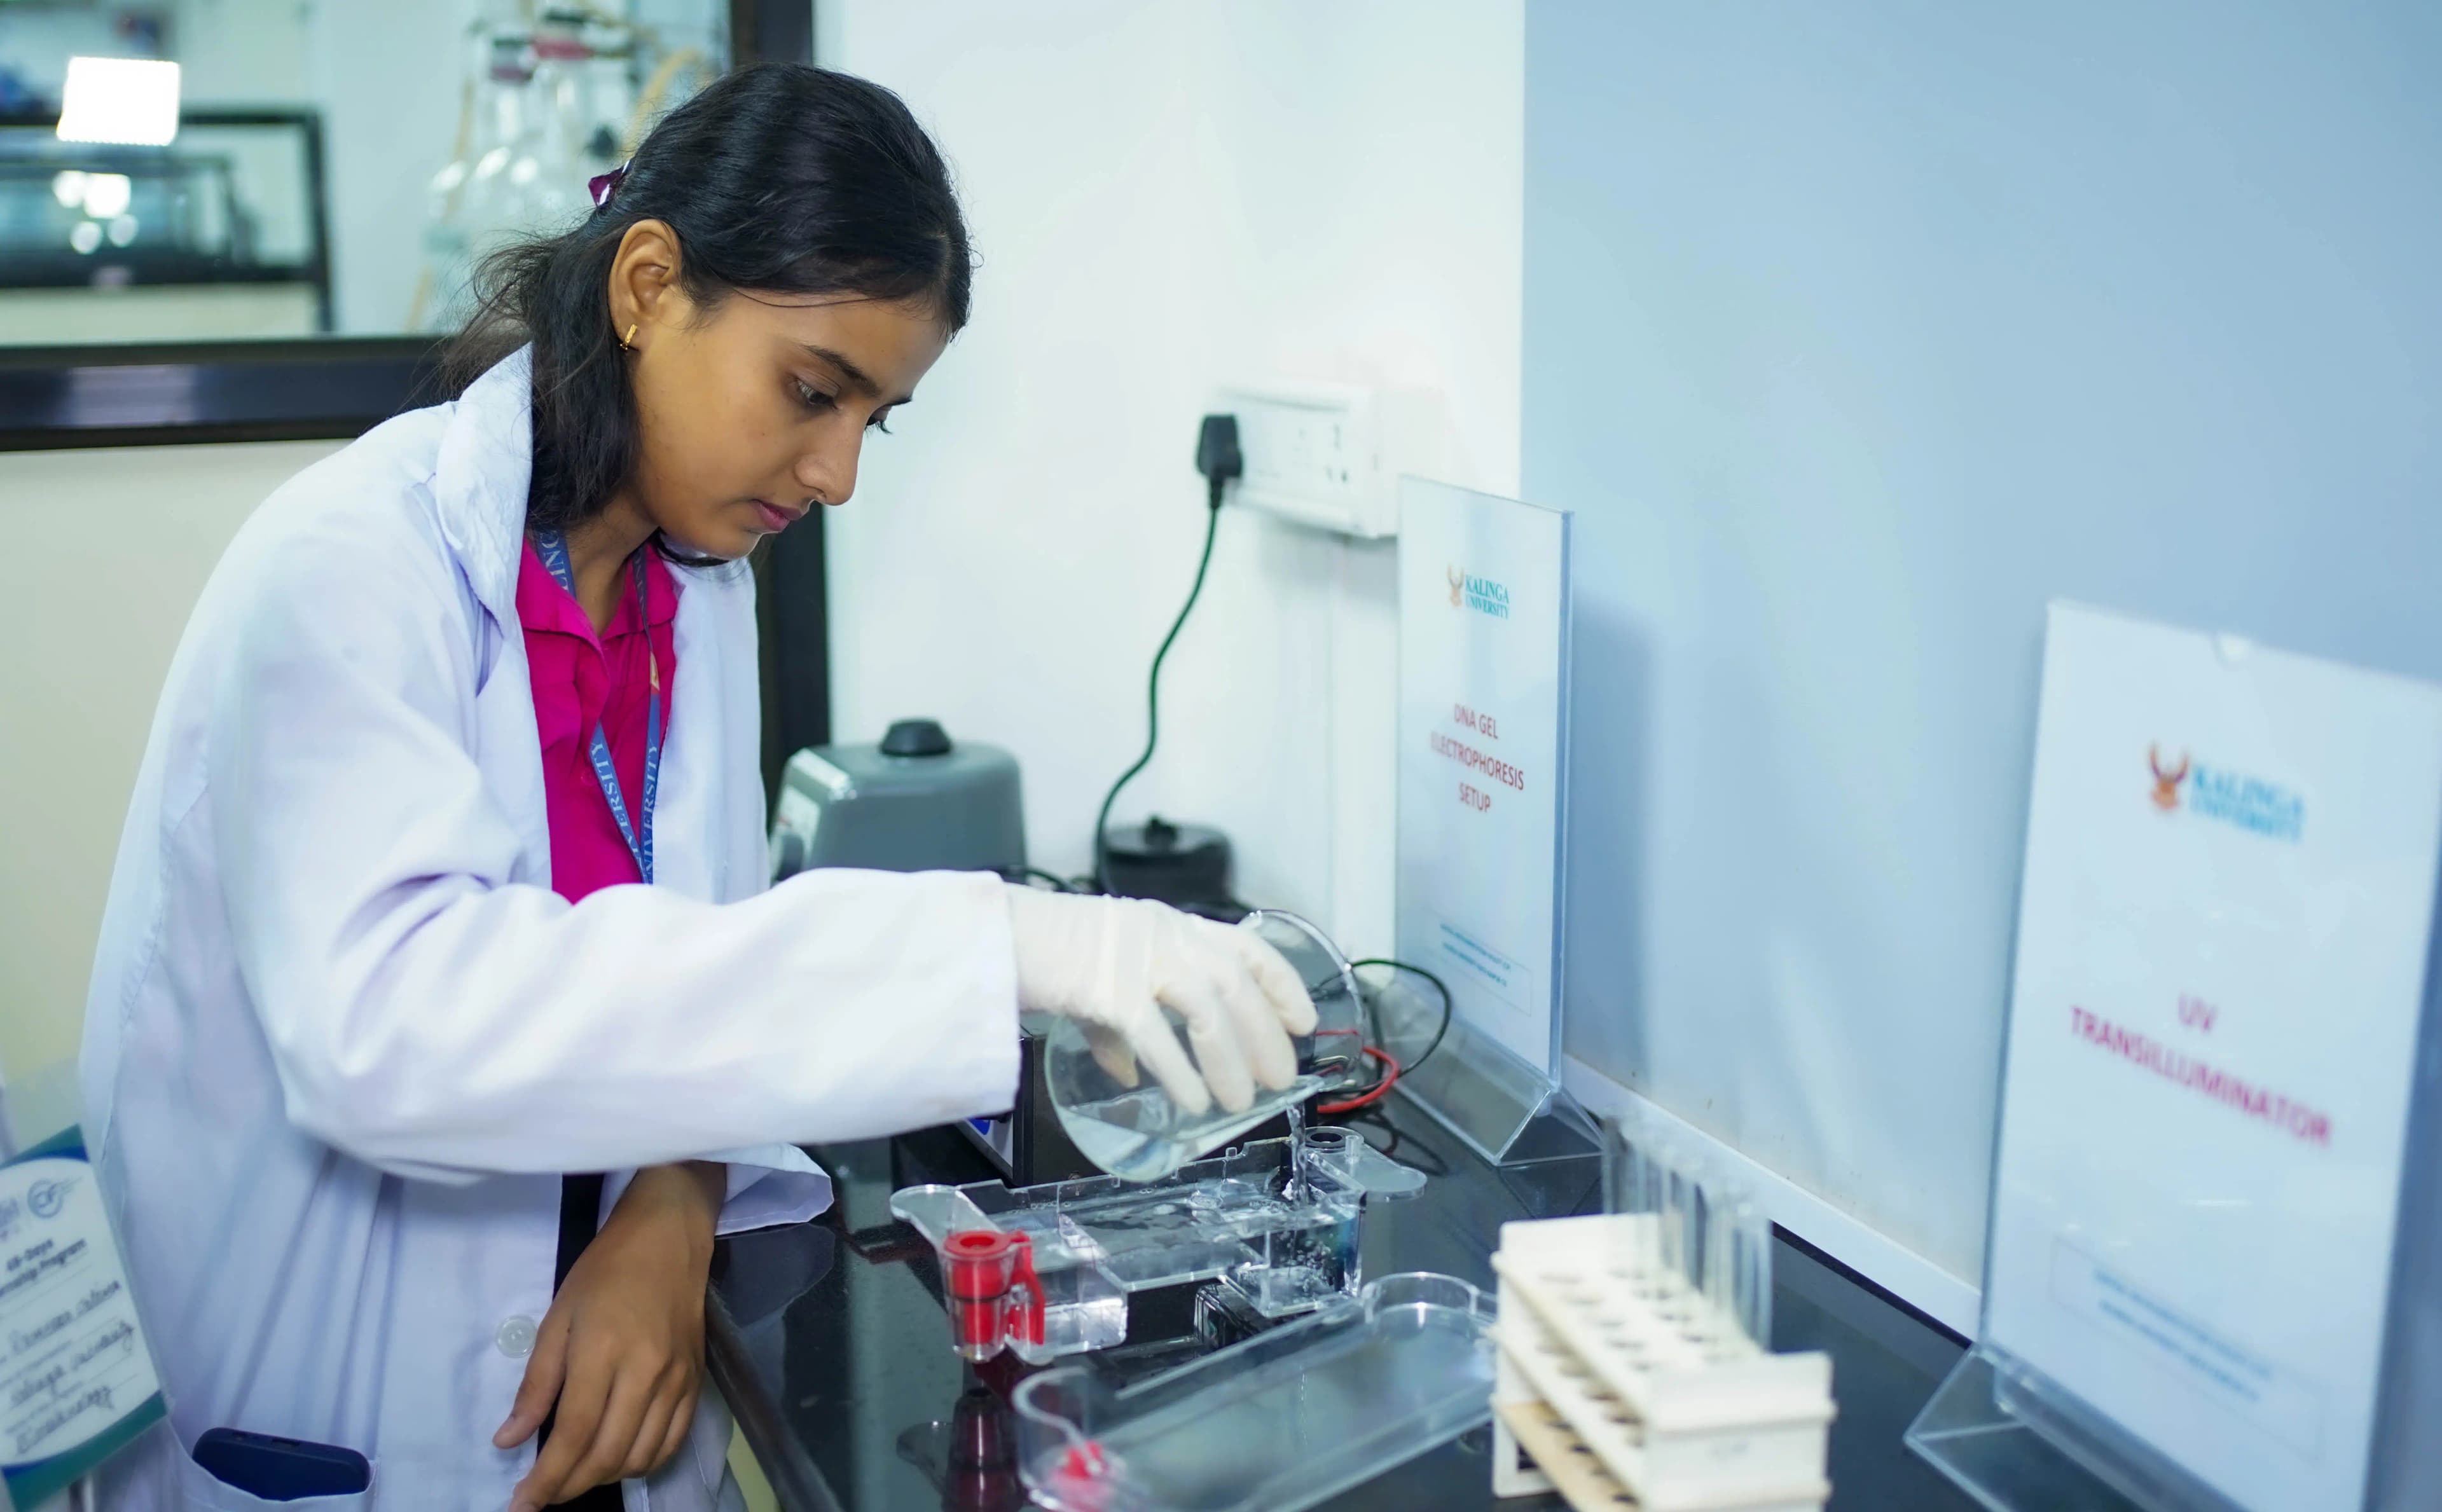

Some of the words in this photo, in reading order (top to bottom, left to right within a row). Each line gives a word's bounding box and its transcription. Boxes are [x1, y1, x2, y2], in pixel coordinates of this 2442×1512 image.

[1465, 574, 1509, 604] KALINGA
[1465, 594, 1508, 621] UNIVERSITY
[1454, 703, 1476, 730] DNA
[1479, 713, 1498, 740] GEL
[1430, 731, 1524, 790] ELECTROPHORESIS
[1459, 782, 1491, 813] SETUP
[2178, 993, 2217, 1034] UV
[2071, 1005, 2331, 1147] TRANSILLUMINATOR
